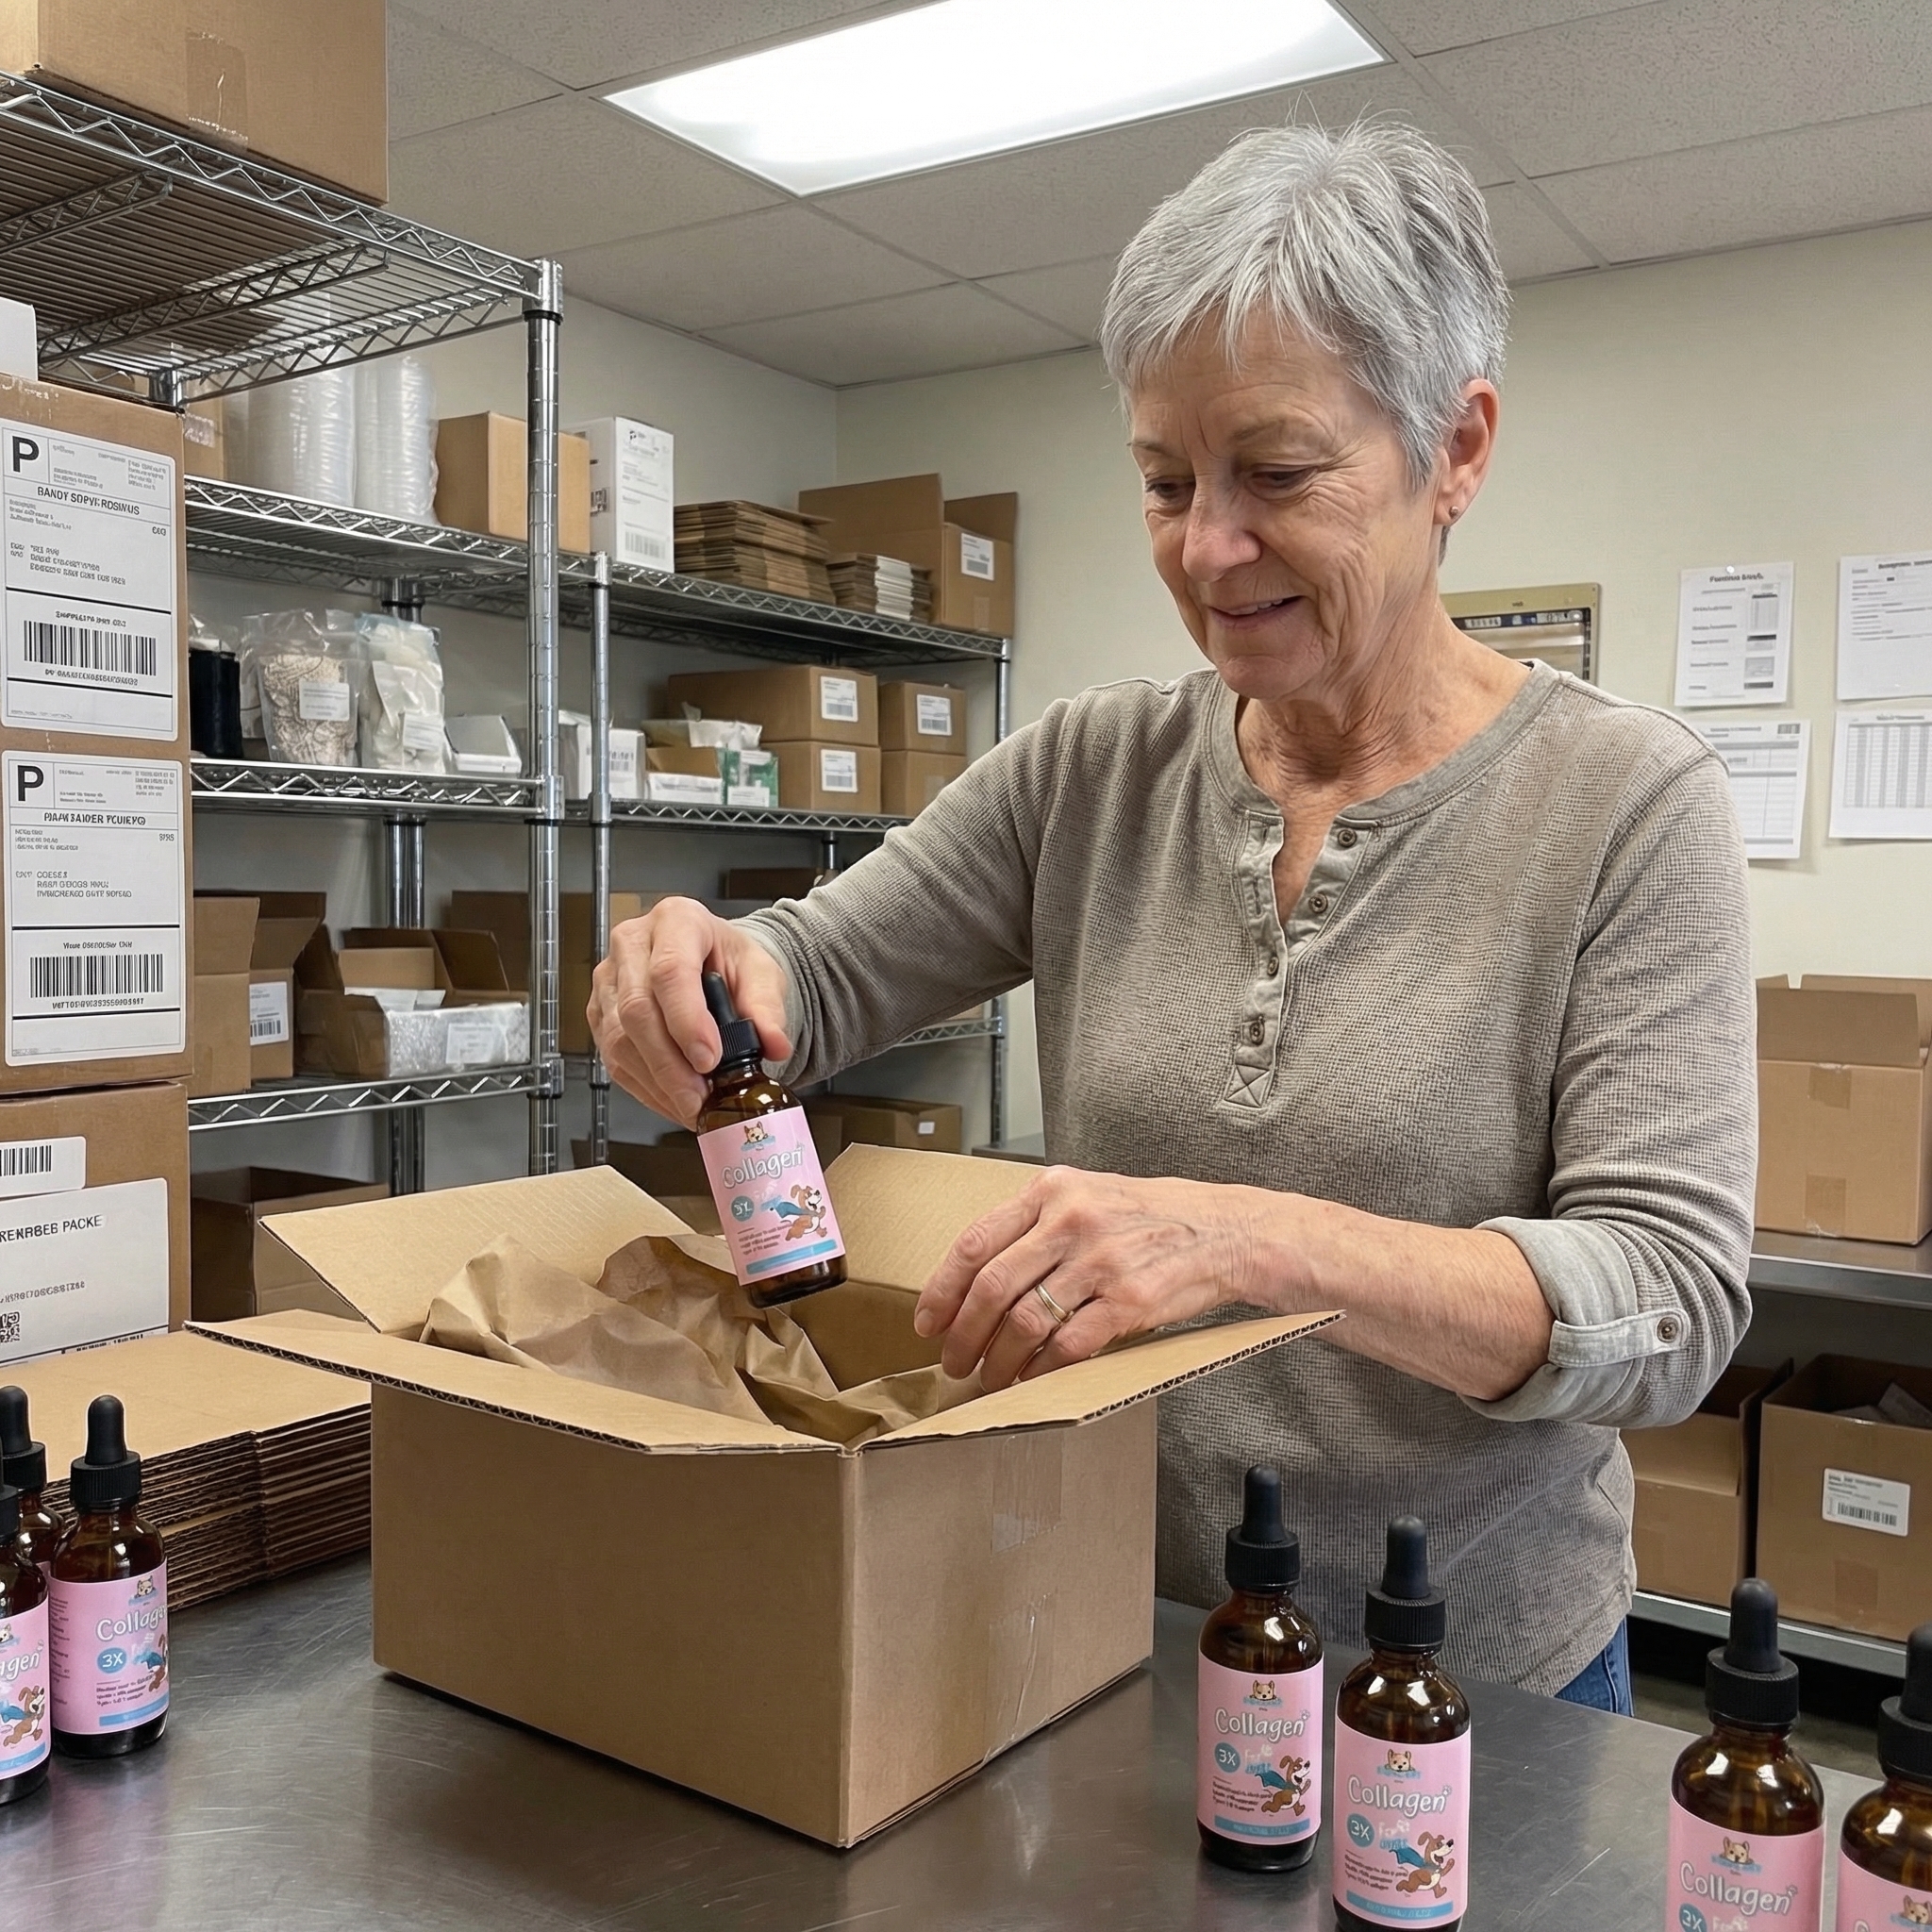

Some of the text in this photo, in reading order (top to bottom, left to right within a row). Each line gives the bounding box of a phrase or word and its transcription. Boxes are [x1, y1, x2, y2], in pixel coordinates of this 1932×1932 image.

[12, 436, 40, 473] P
[17, 765, 44, 801] P
[721, 1145, 805, 1190] Collagen
[102, 1651, 124, 1669] 3X
[1214, 1707, 1307, 1743] Collagen
[1218, 1748, 1237, 1767] 3X
[1346, 1774, 1447, 1820] Collagen
[1350, 1819, 1371, 1841] 3X
[1679, 1859, 1792, 1917] Collagen
[1681, 1909, 1703, 1932] 3X
